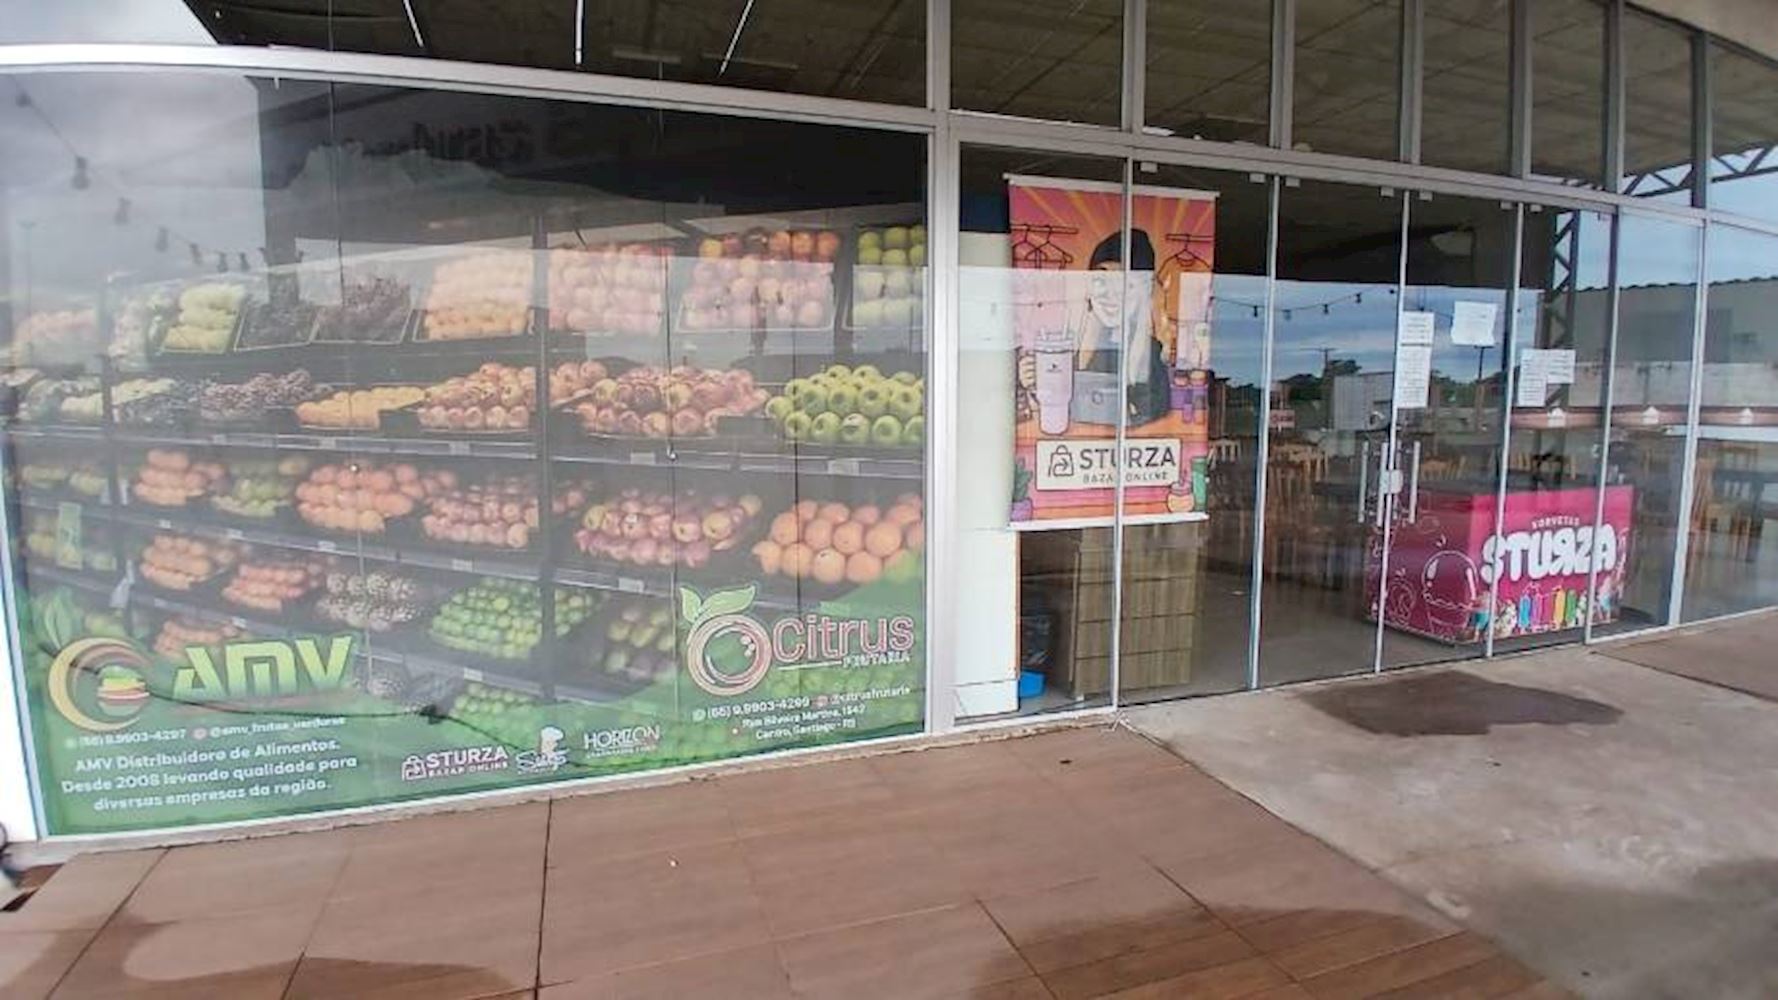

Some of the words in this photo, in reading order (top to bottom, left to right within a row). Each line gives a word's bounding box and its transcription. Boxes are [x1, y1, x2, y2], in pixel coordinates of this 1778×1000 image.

[1080, 447, 1176, 469] STURZA
[1083, 473, 1123, 484] BAZA
[172, 636, 352, 698] AMV
[584, 725, 660, 749] HORIZON
[75, 758, 113, 772] AMV
[117, 751, 227, 769] Distribuidora
[229, 746, 251, 759] de
[254, 740, 341, 758] Alimentos.
[426, 746, 508, 768] STURZA
[62, 778, 113, 793] Desde
[116, 773, 160, 788] 2008
[163, 768, 230, 785] levando
[233, 760, 316, 781] qualidade
[318, 757, 358, 773] para
[94, 796, 163, 811] diversas
[165, 788, 247, 805] empresas
[248, 784, 271, 796] da
